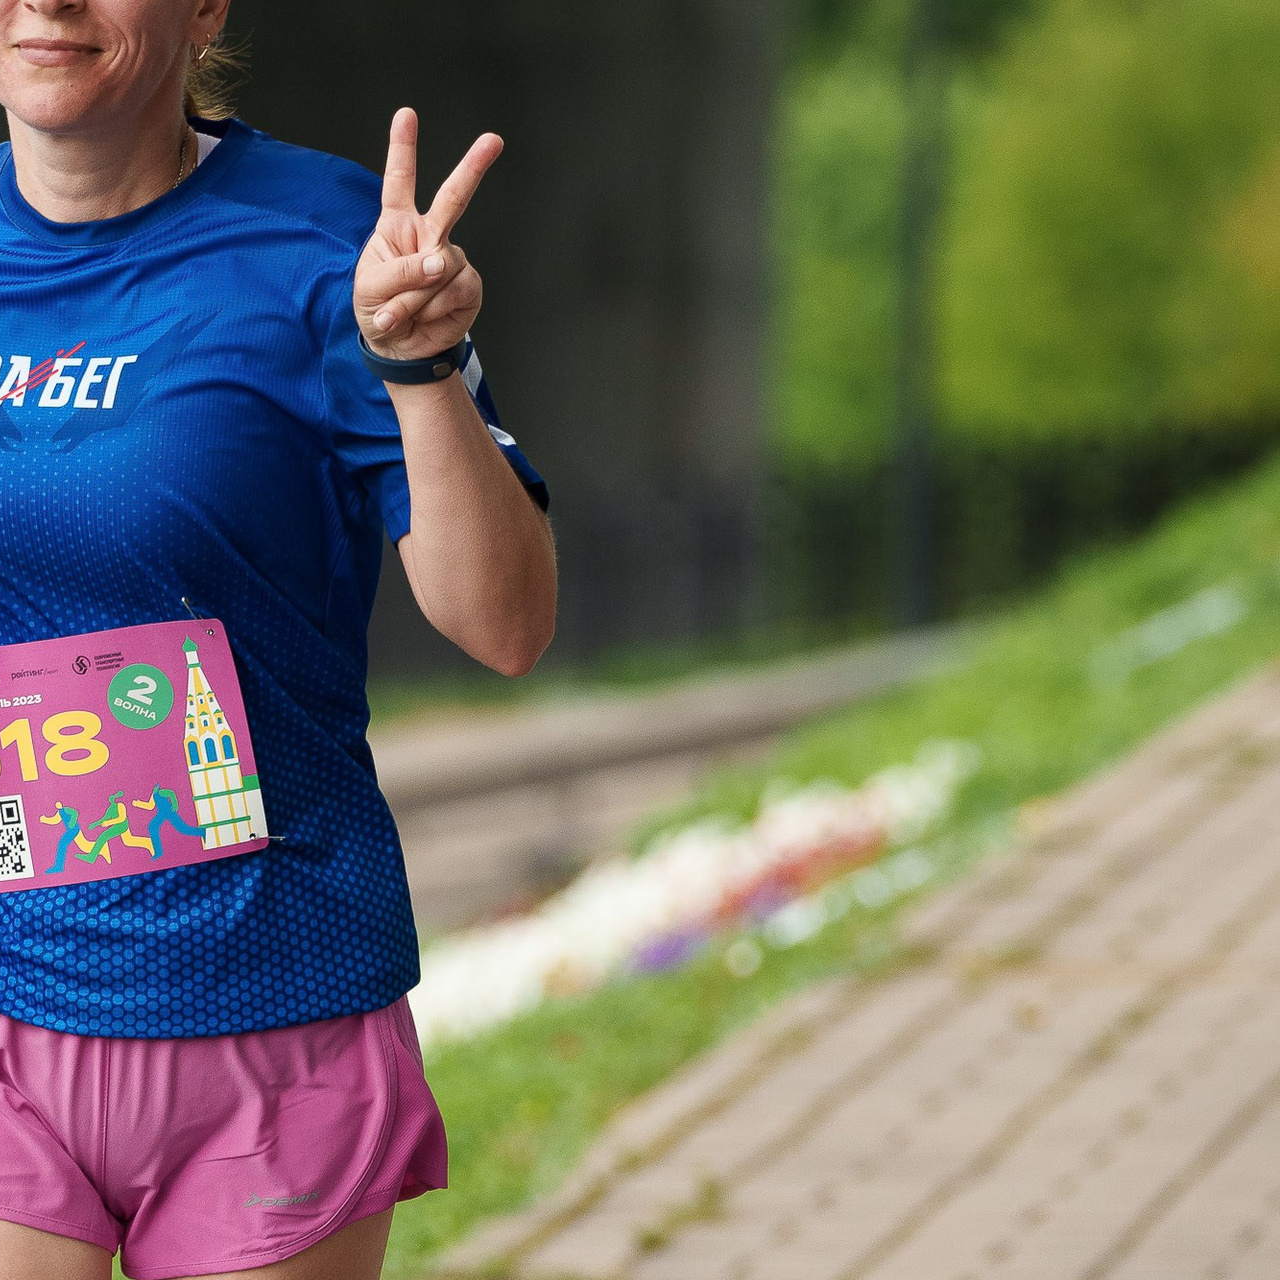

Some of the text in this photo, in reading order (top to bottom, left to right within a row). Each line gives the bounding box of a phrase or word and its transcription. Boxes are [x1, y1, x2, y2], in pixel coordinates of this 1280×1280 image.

[12, 693, 43, 707] 2023
[126, 675, 157, 705] 2
[113, 697, 157, 721] ВОЛНА
